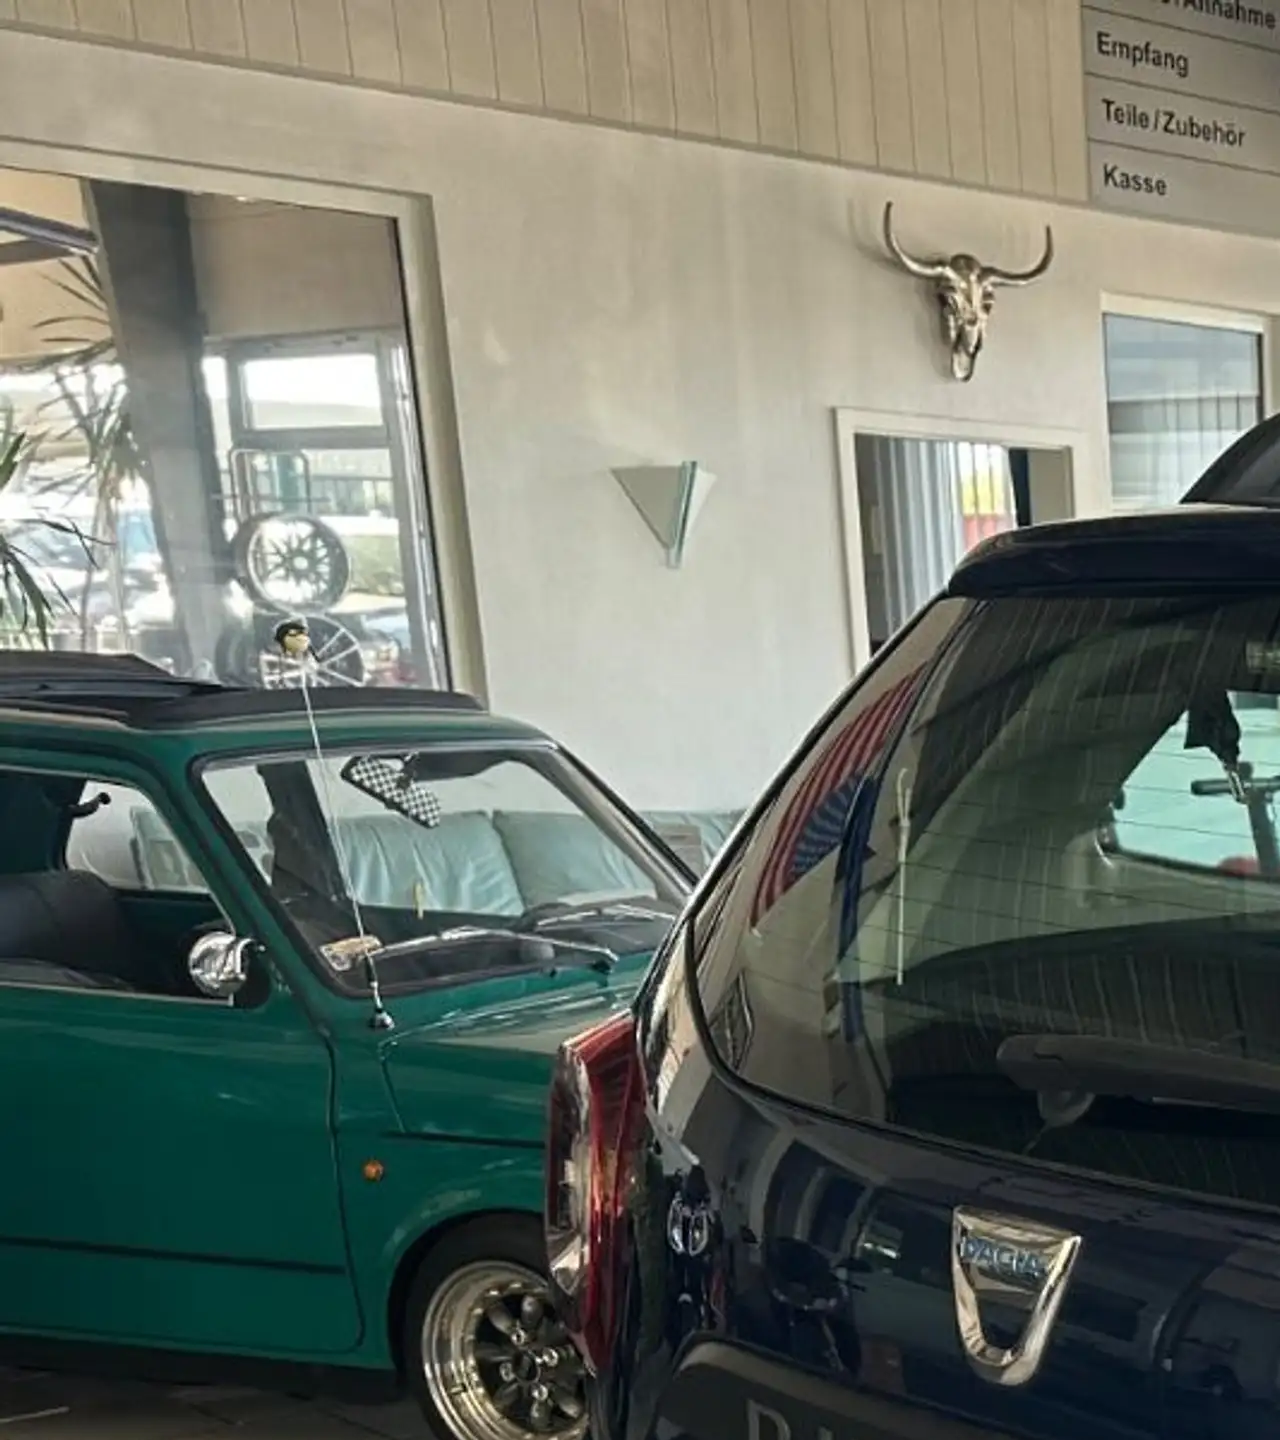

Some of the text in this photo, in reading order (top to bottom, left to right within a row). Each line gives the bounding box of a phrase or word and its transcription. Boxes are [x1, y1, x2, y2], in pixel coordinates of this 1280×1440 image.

[1096, 31, 1190, 78] Empfang
[1101, 98, 1247, 148] Teile/Zubehör
[1103, 163, 1168, 196] Kasse
